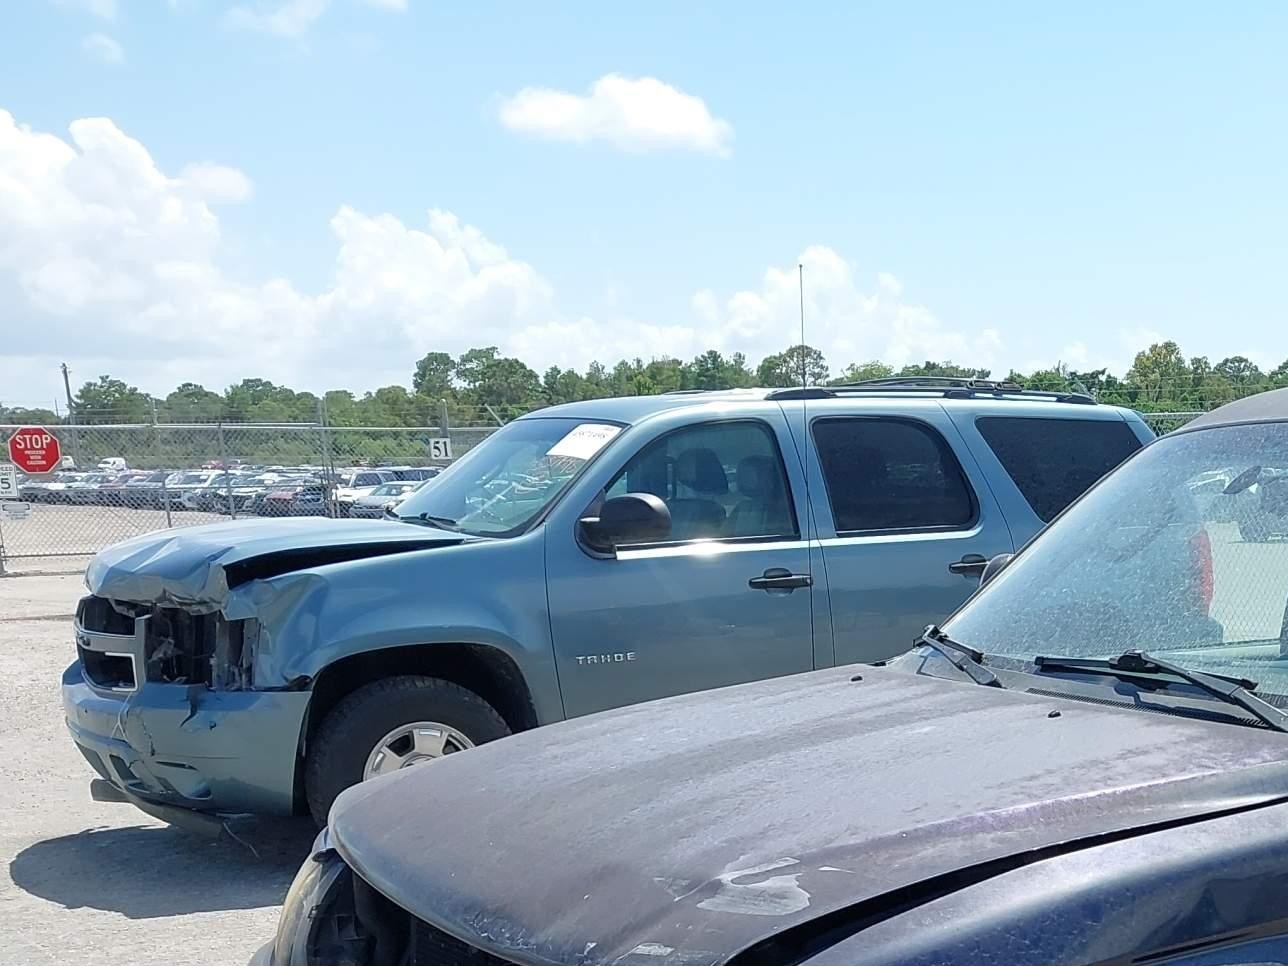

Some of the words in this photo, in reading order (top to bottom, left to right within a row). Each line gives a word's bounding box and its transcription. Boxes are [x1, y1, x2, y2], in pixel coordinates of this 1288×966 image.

[15, 434, 52, 449] STOP
[433, 440, 450, 458] 51
[575, 651, 637, 665] TAHOE
